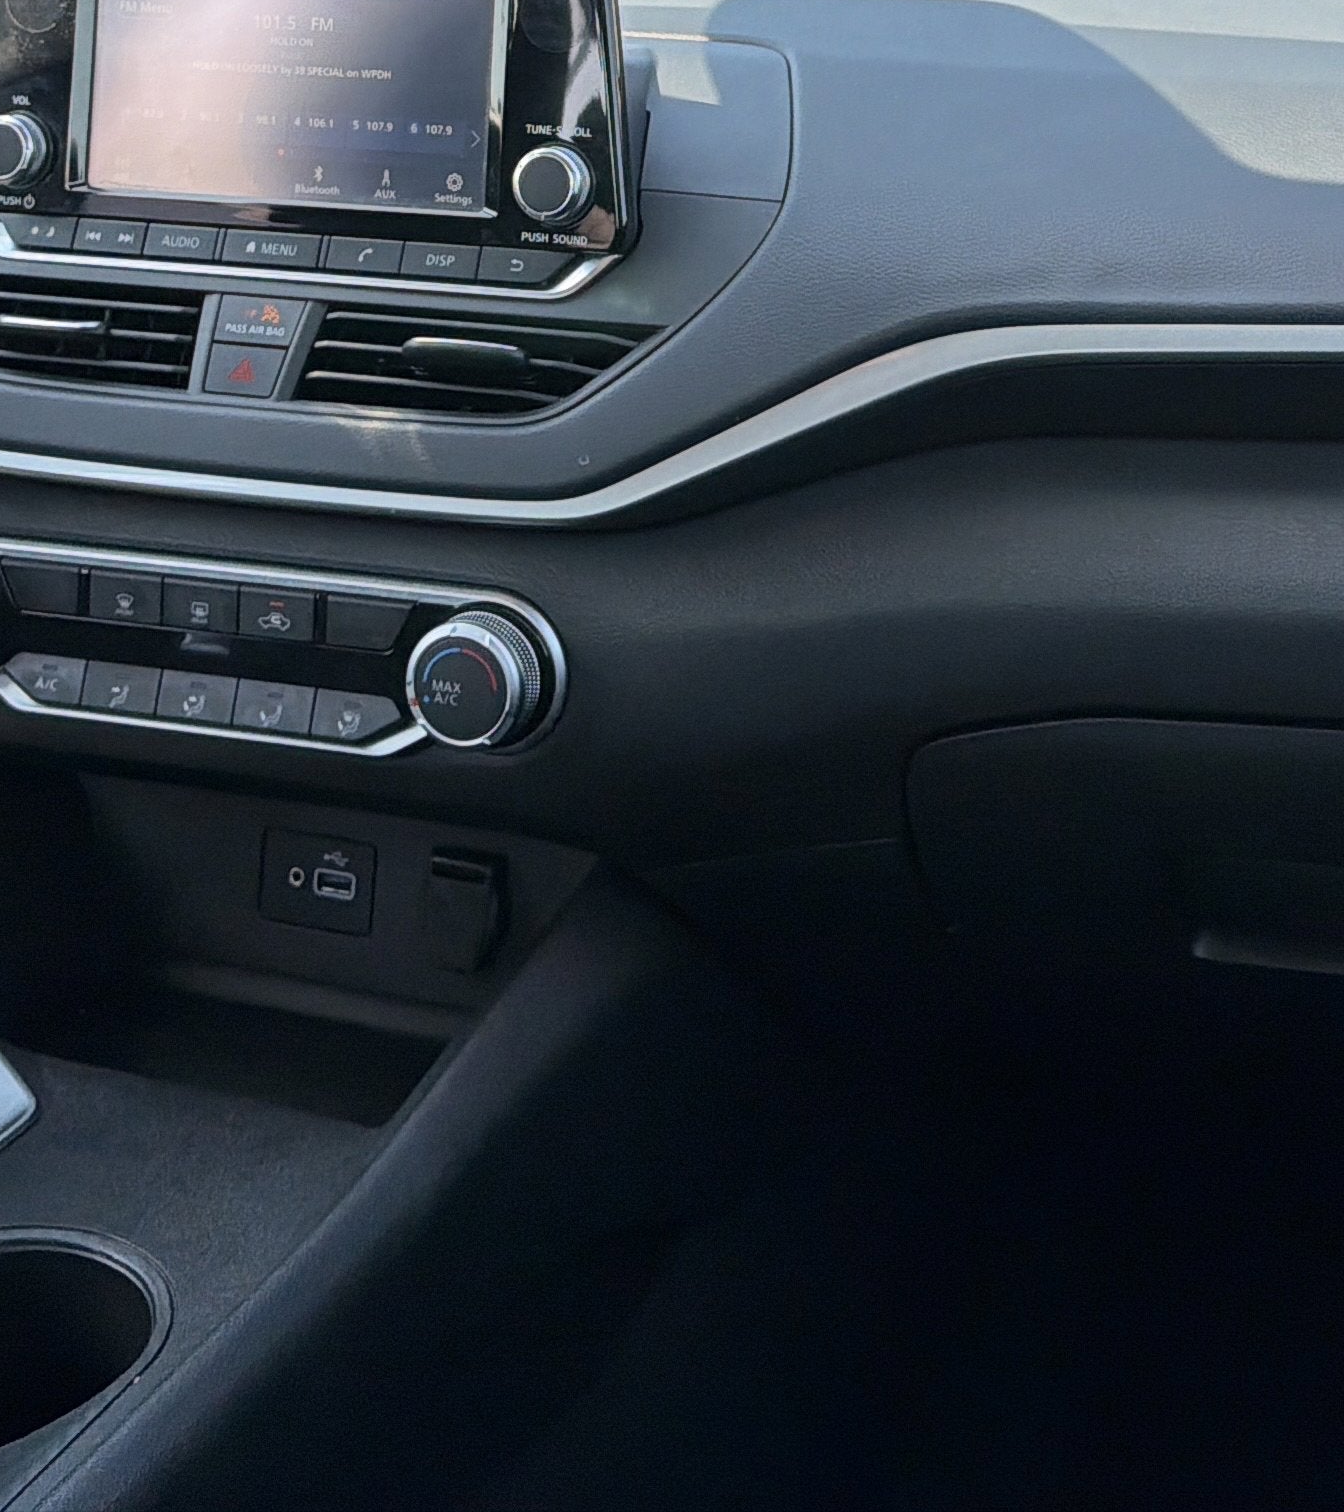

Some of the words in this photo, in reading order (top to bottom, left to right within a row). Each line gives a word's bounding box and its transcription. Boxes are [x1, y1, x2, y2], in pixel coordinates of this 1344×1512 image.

[255, 14, 296, 30] 101.5
[310, 17, 334, 32] FM
[280, 65, 291, 76] by
[306, 66, 344, 78] SPECIAL
[346, 70, 359, 78] on
[11, 94, 32, 106] VOL
[294, 117, 301, 127] 4
[308, 118, 334, 129] 106.1
[352, 120, 359, 130] 5
[366, 121, 394, 133] 107.9
[410, 123, 418, 134] 6
[425, 124, 453, 136] 107.9
[294, 183, 340, 195] Bluetooth
[374, 188, 397, 200] AUX
[434, 192, 472, 206] Settings
[161, 233, 201, 249] AUDIO
[521, 231, 549, 243] PUSH
[552, 233, 588, 246] SOUND
[261, 241, 298, 257] MENU
[425, 252, 456, 267] DISP
[224, 322, 247, 334] PASS
[248, 324, 265, 335] AIR
[265, 326, 286, 337] BAG
[33, 675, 59, 692] A/C
[431, 678, 462, 694] MAX
[433, 691, 459, 707] A/C
